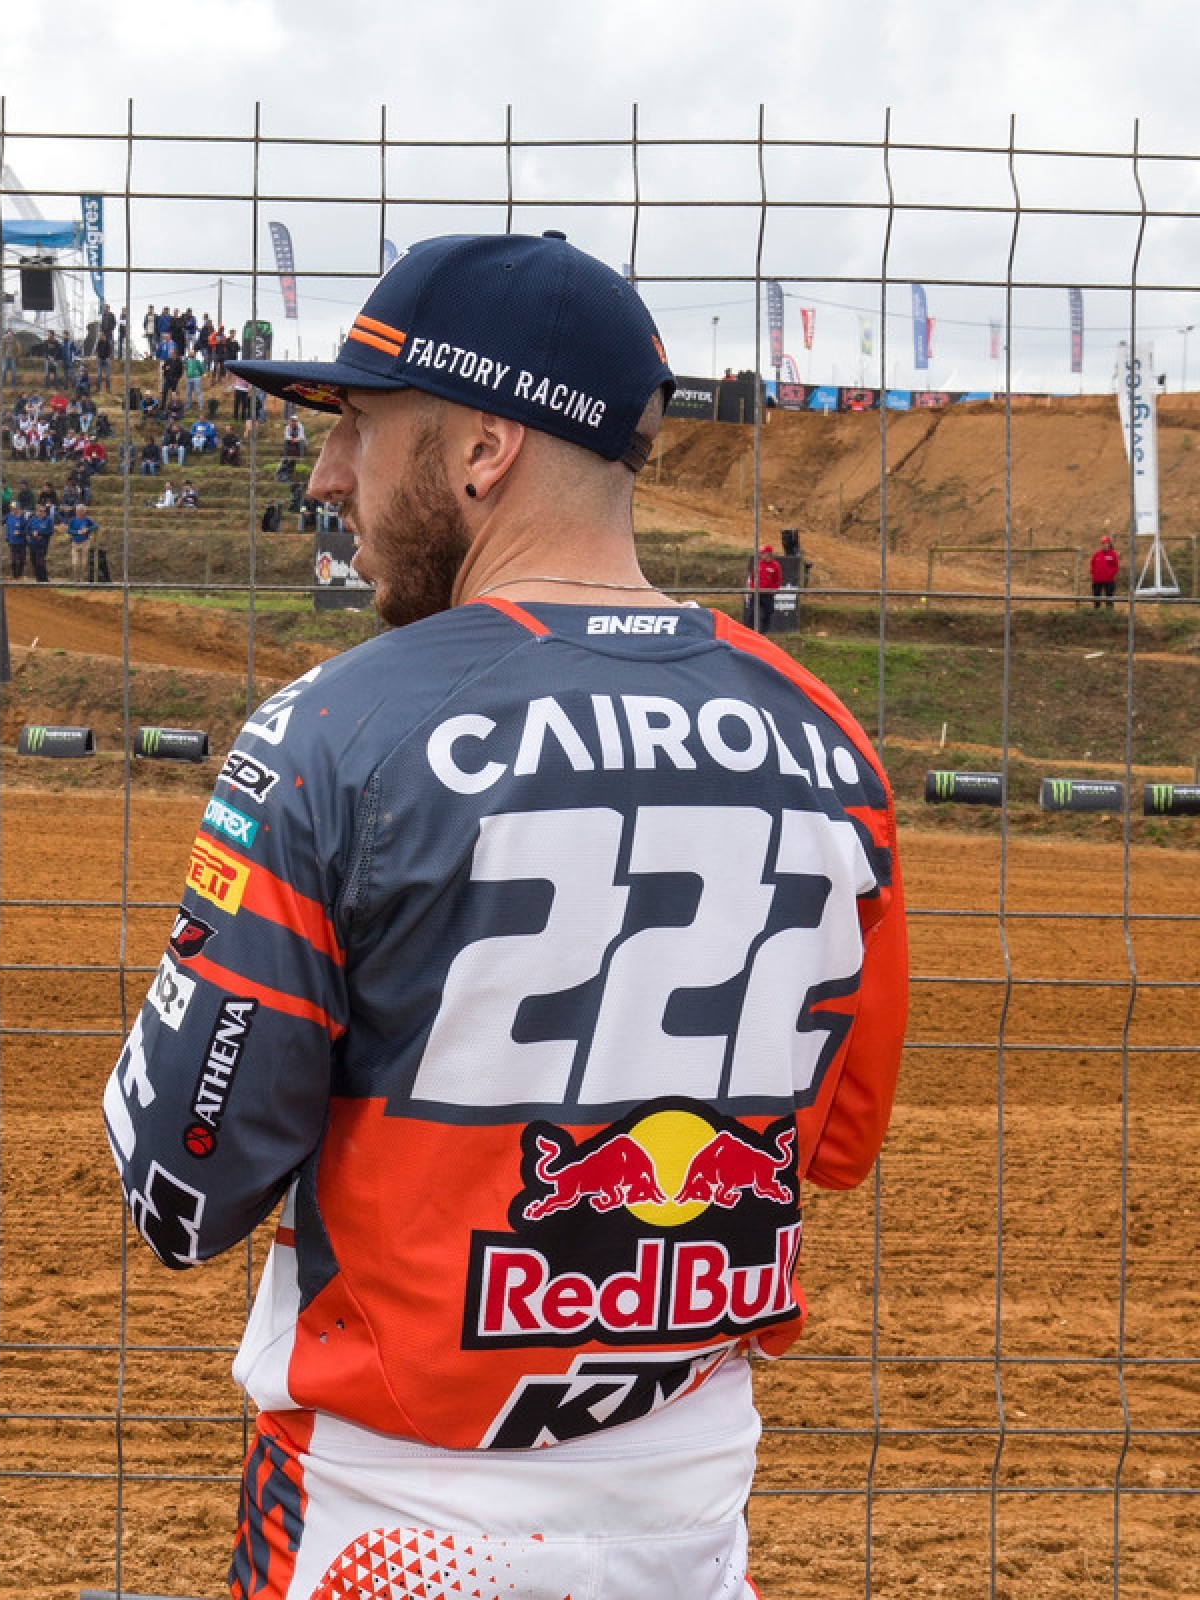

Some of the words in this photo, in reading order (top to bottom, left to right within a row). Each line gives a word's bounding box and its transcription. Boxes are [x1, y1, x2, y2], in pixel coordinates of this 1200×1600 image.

[406, 337, 511, 390] FACTORY
[513, 369, 607, 429] RACING
[427, 695, 835, 794] CAIROLI
[410, 805, 878, 1105] 222
[194, 1001, 255, 1127] ATHENA
[477, 1238, 666, 1337] Red
